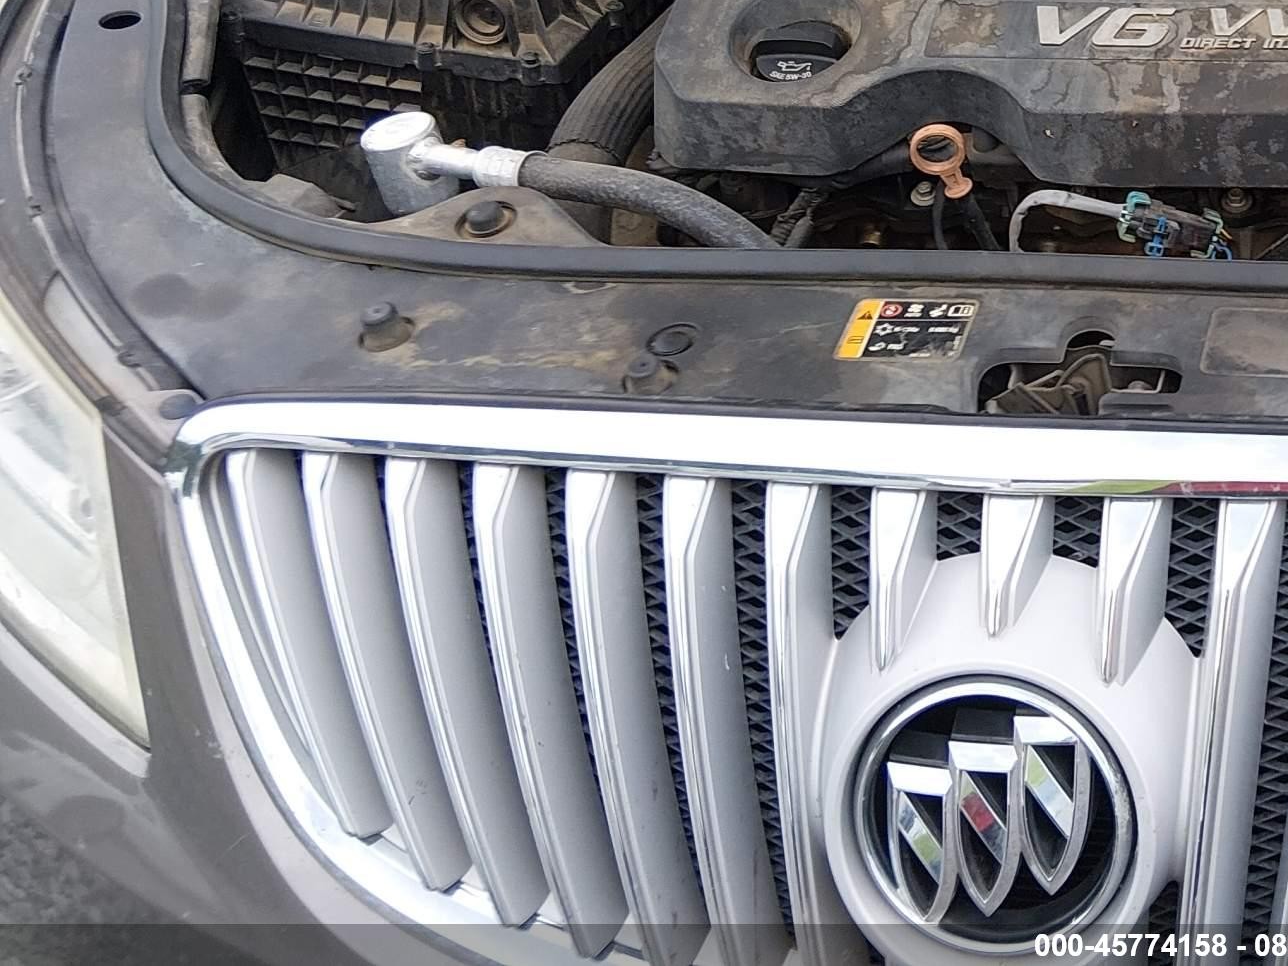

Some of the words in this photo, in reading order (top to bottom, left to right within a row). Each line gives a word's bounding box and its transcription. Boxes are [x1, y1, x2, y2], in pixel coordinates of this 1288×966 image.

[1036, 5, 1176, 48] V6
[1180, 37, 1256, 50] DIRECT
[769, 71, 785, 80] SAE
